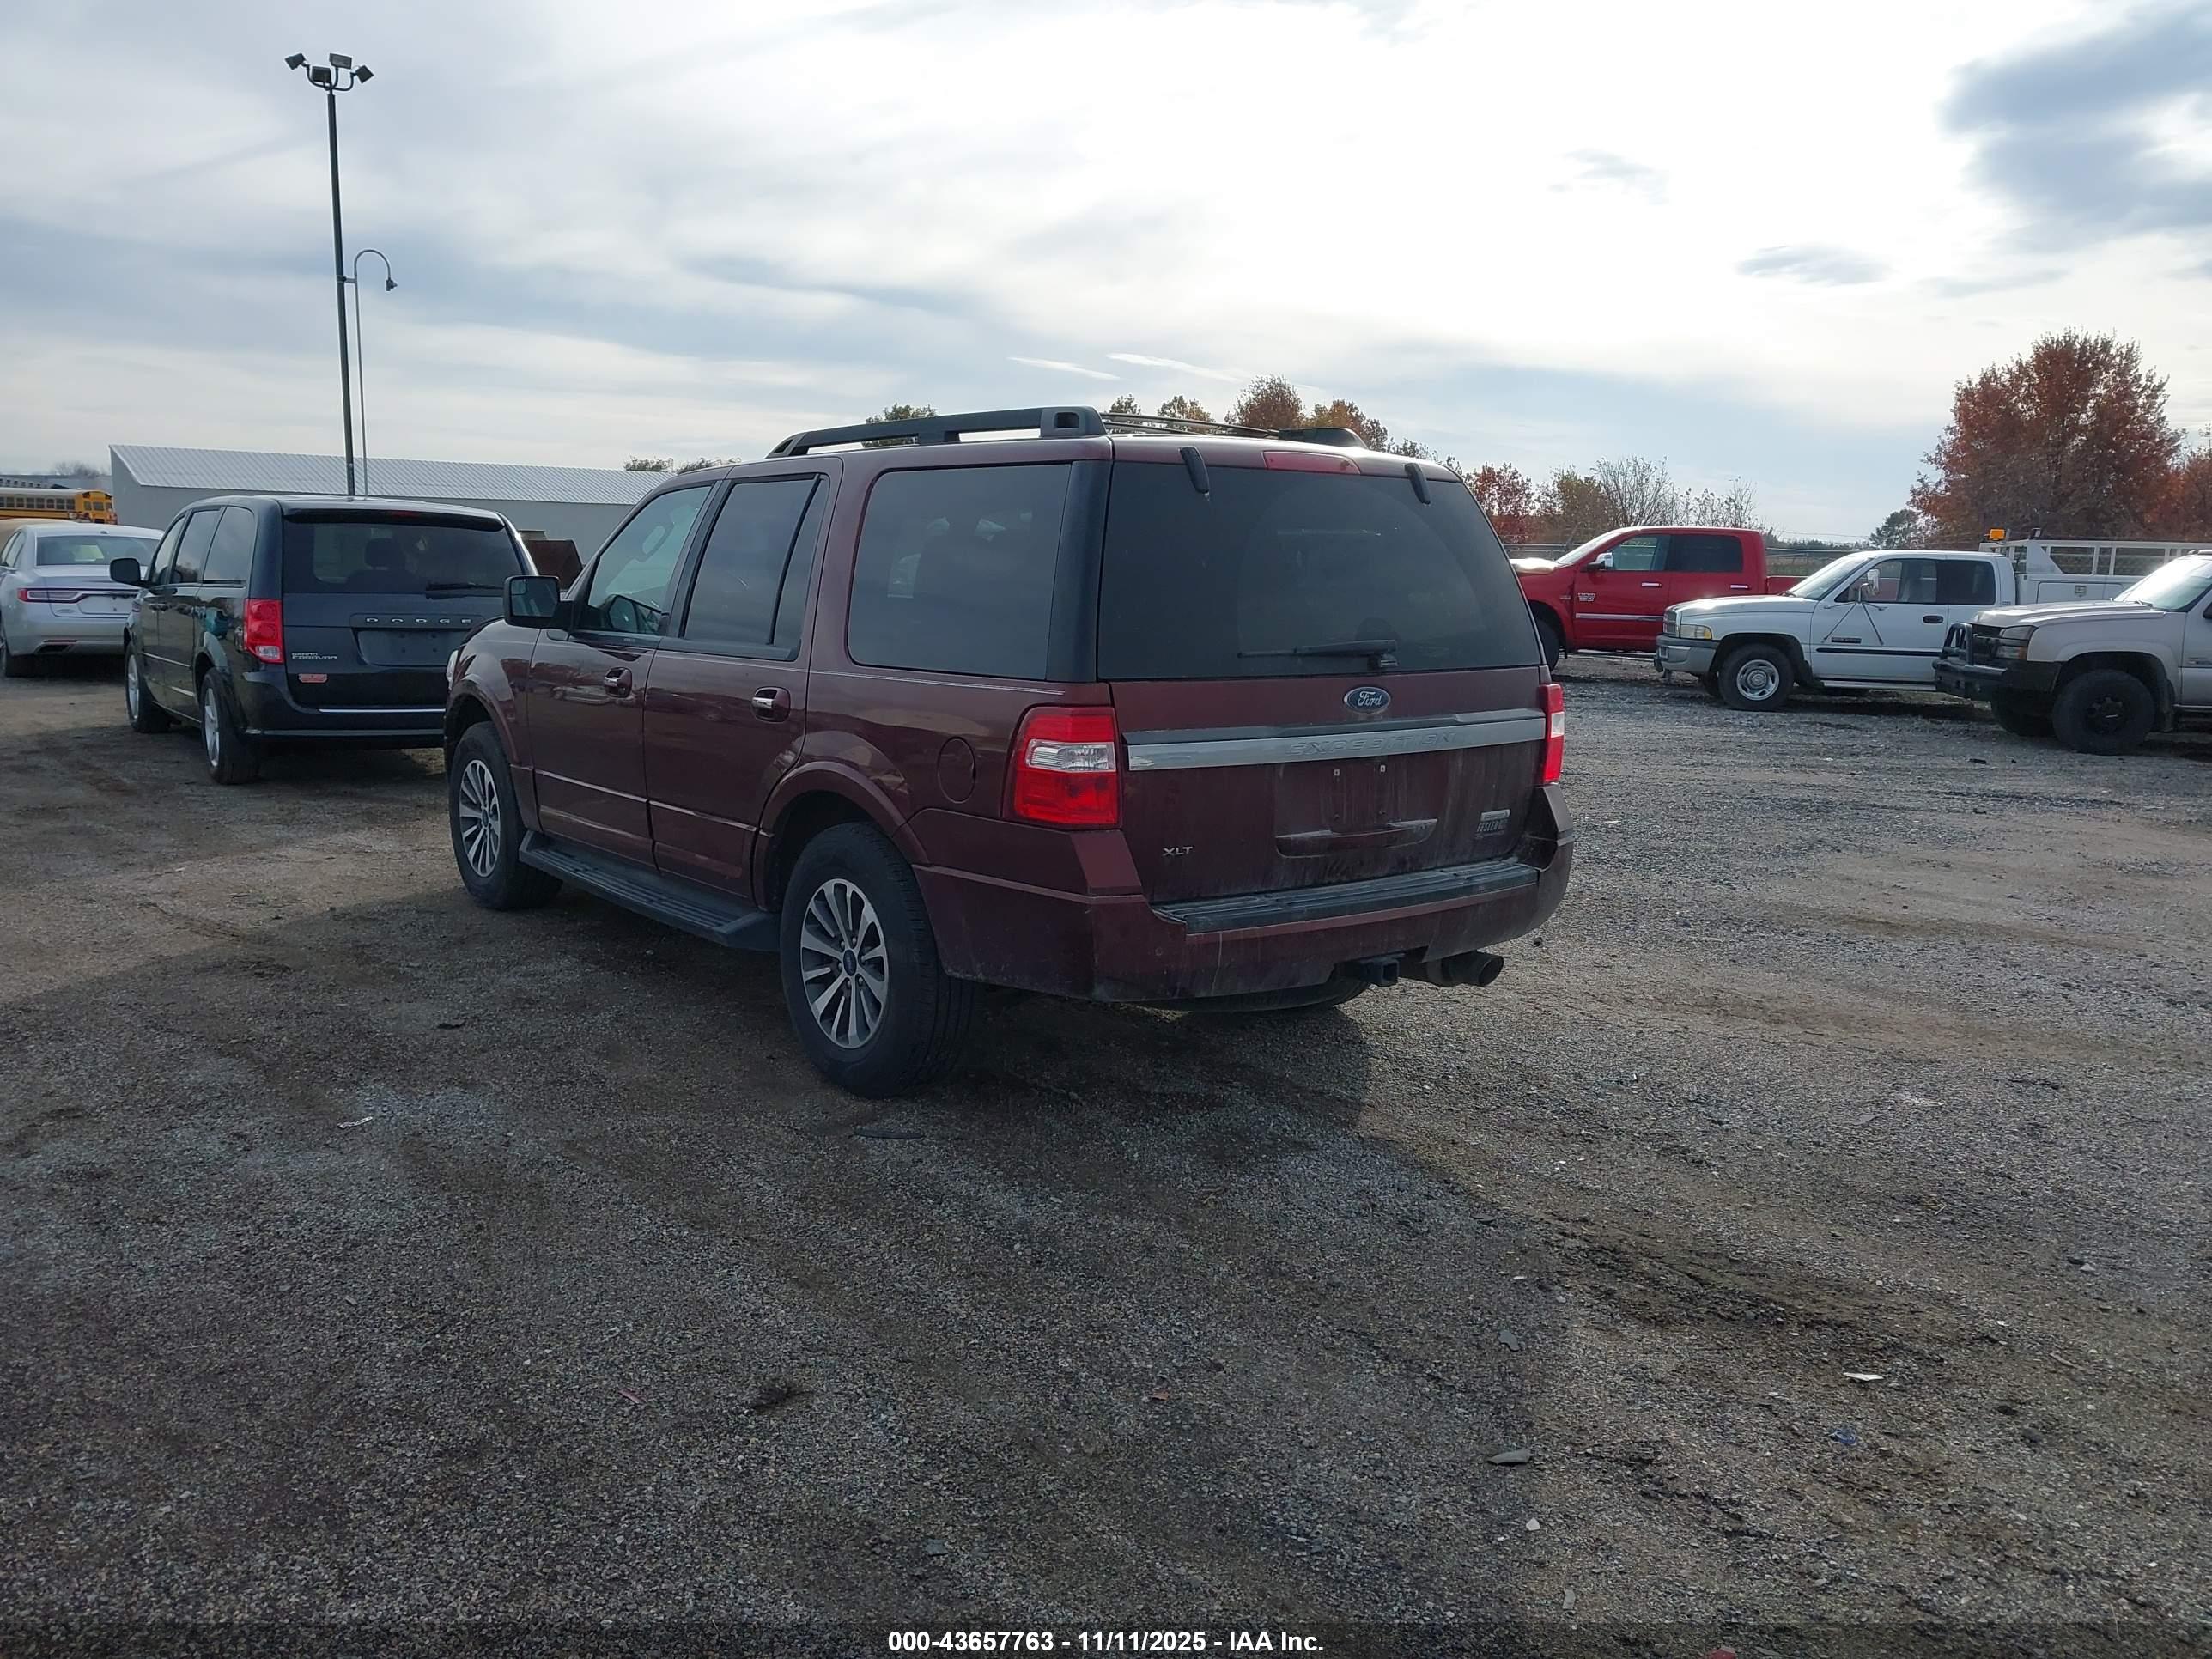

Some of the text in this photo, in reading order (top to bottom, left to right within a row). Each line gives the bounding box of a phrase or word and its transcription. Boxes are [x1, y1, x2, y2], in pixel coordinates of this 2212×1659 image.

[1357, 690, 1383, 707] Ford
[1288, 731, 1456, 756] EXPEDITION
[1162, 846, 1194, 857] XLT
